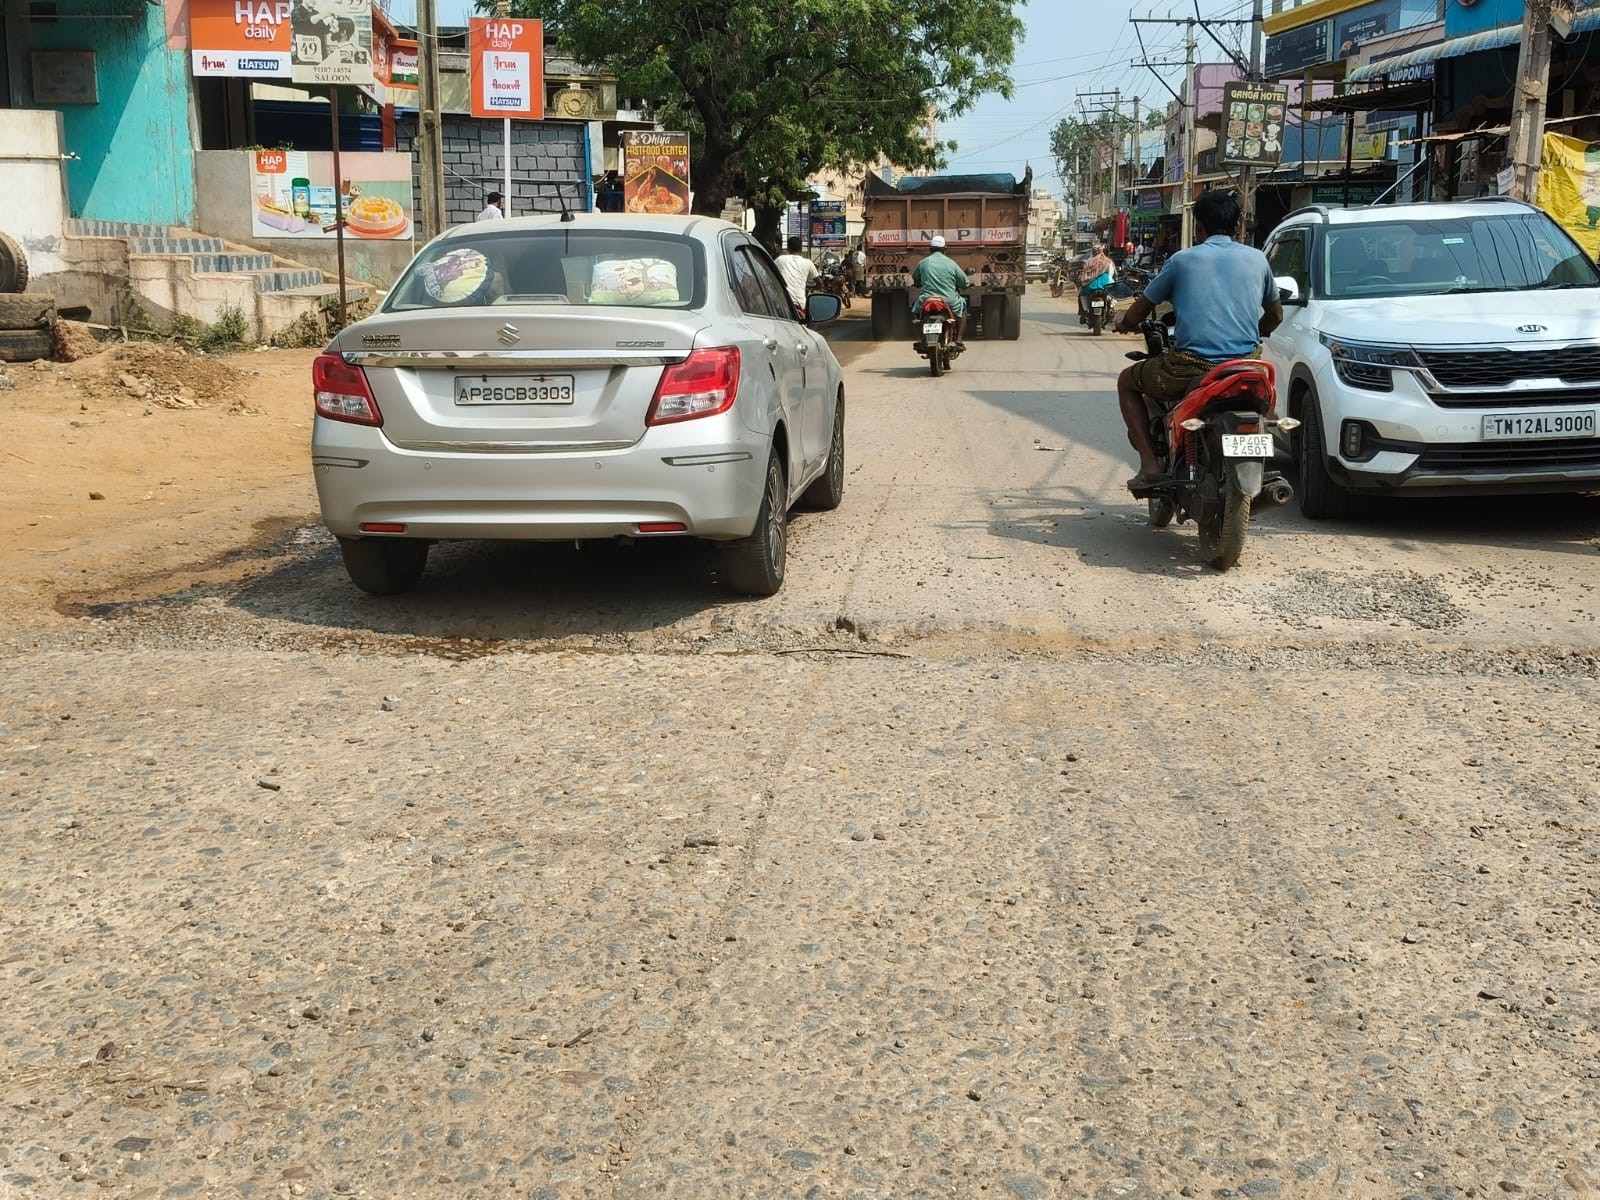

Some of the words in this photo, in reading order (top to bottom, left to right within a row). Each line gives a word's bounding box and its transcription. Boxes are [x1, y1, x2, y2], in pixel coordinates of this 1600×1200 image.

[235, 1, 290, 24] HAP
[244, 26, 277, 41] daily
[485, 23, 523, 39] HAP
[301, 41, 318, 56] 49
[491, 39, 513, 50] daily
[201, 55, 226, 71] Arun
[239, 59, 279, 70] HATSUN
[493, 56, 516, 70] Arun
[1389, 65, 1422, 81] NIPPON
[490, 97, 521, 106] HATSUN
[1231, 90, 1259, 100] GANGA
[1260, 92, 1286, 101] HOTEL
[625, 145, 660, 155] FASTFOOD
[662, 146, 688, 155] CENTER
[260, 155, 283, 165] HAP
[878, 231, 900, 242] Sound
[920, 230, 934, 241] N
[957, 229, 971, 240] P
[987, 229, 1012, 240] Horn
[458, 386, 571, 402] AP26CB3303
[1493, 415, 1594, 435] TN12AL9000
[1232, 436, 1268, 446] AP40E
[1232, 446, 1268, 456] Z4501
